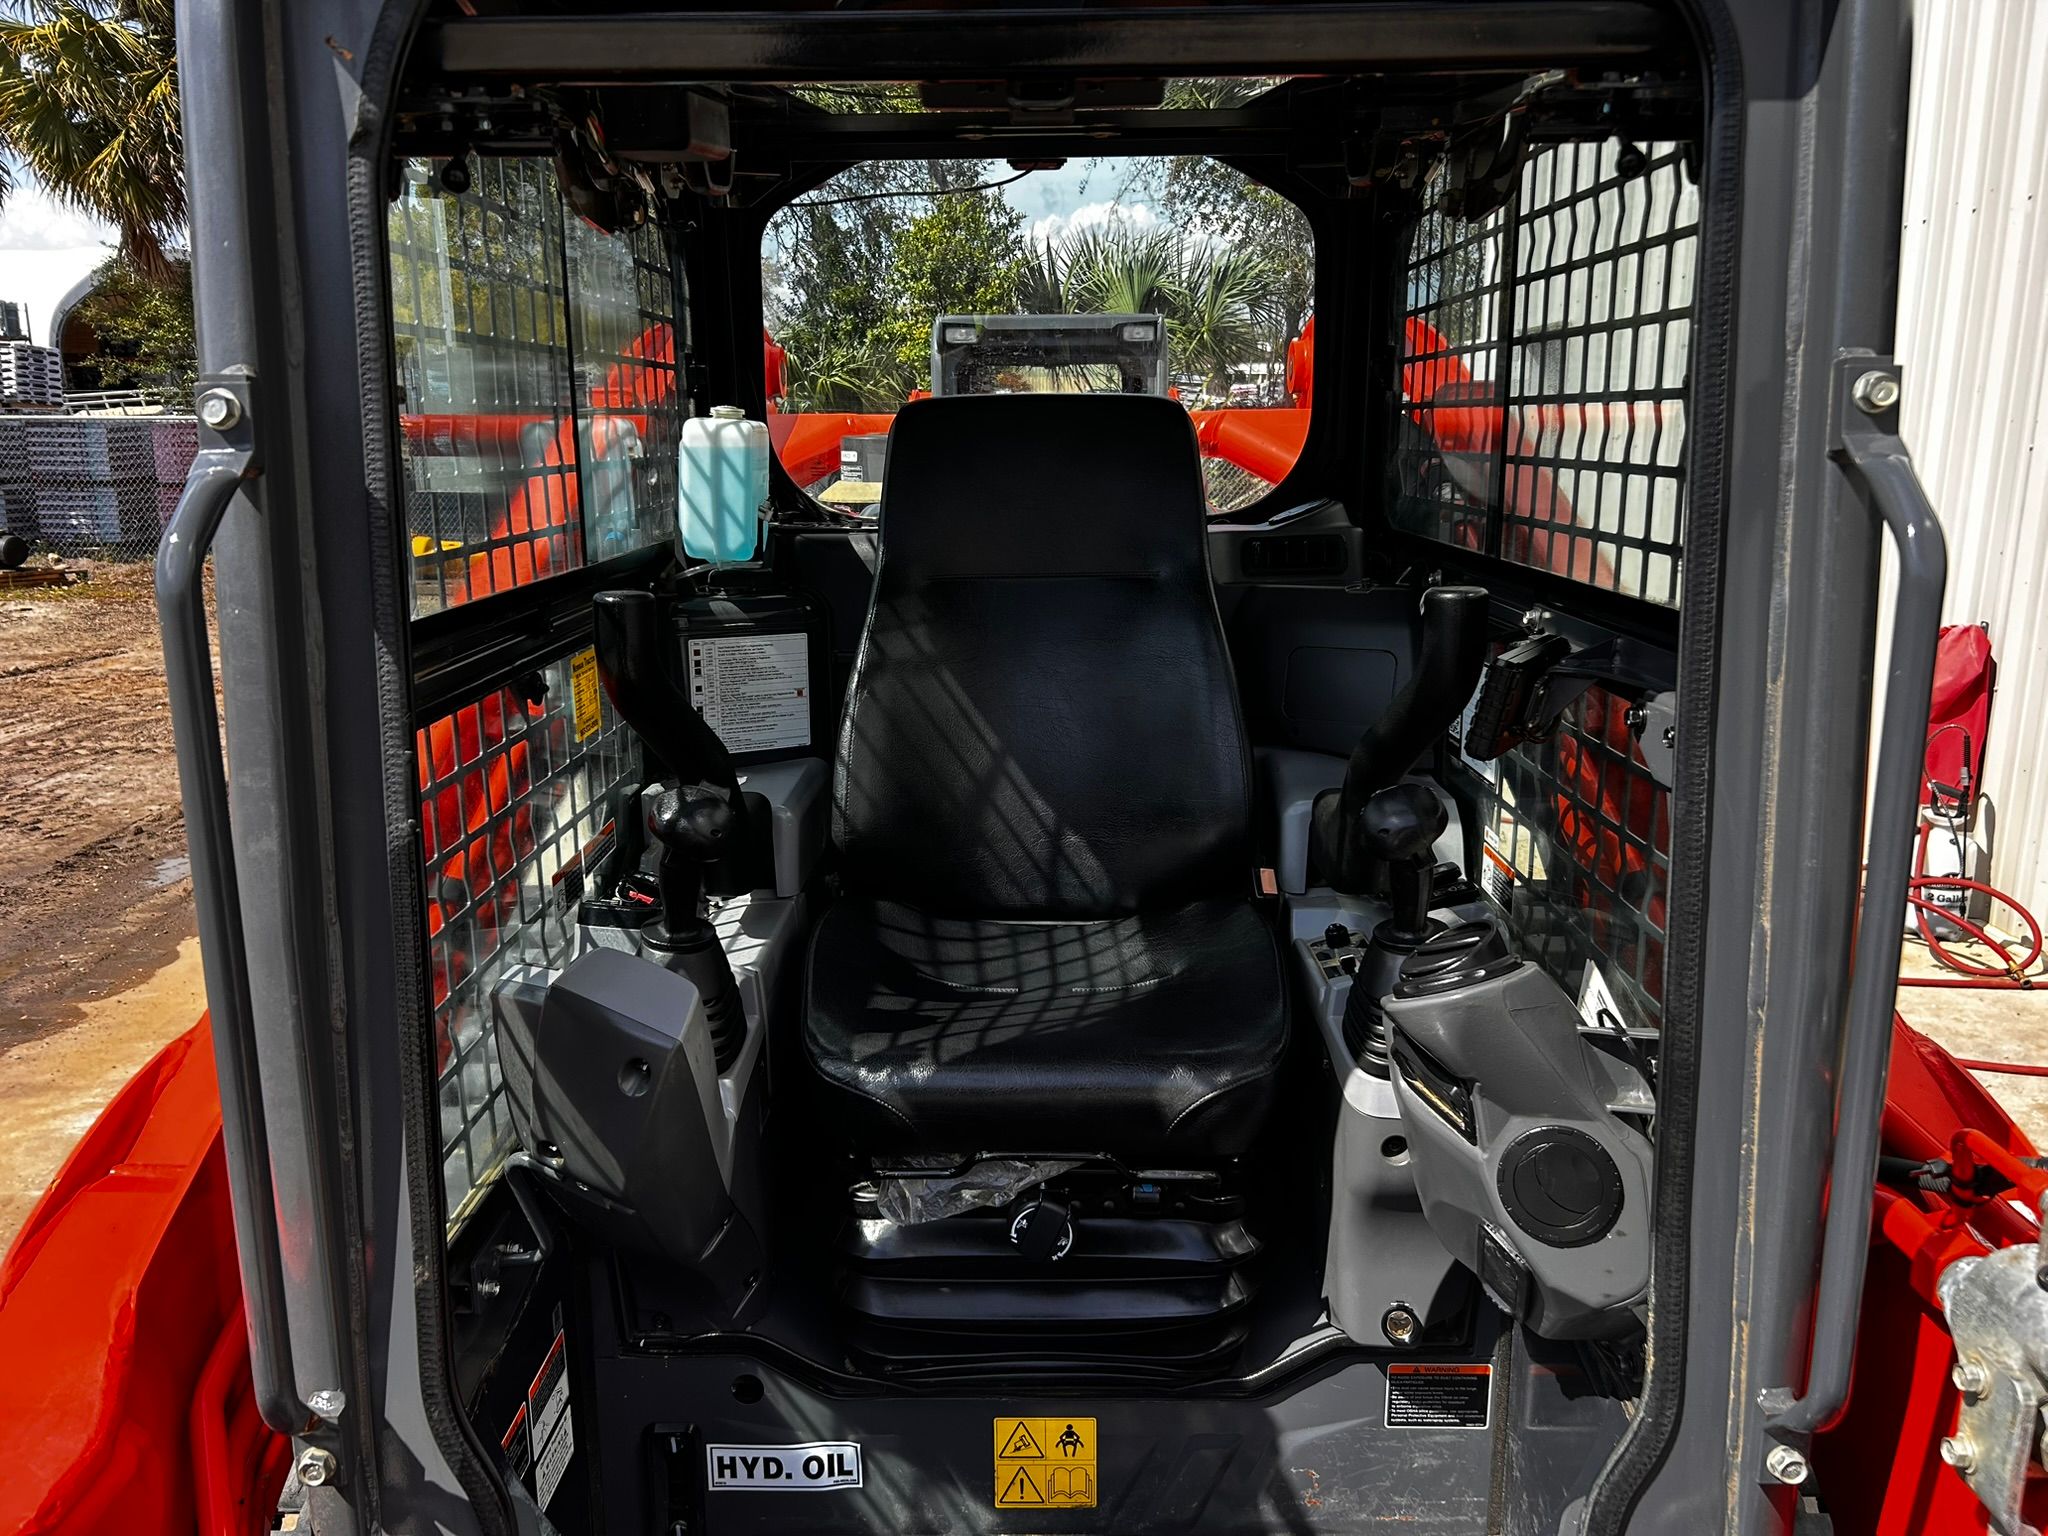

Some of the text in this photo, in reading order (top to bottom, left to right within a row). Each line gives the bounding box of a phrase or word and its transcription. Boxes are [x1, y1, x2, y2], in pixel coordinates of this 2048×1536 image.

[1927, 892, 1934, 901] 2
[717, 1453, 853, 1480] HYD. OIL
